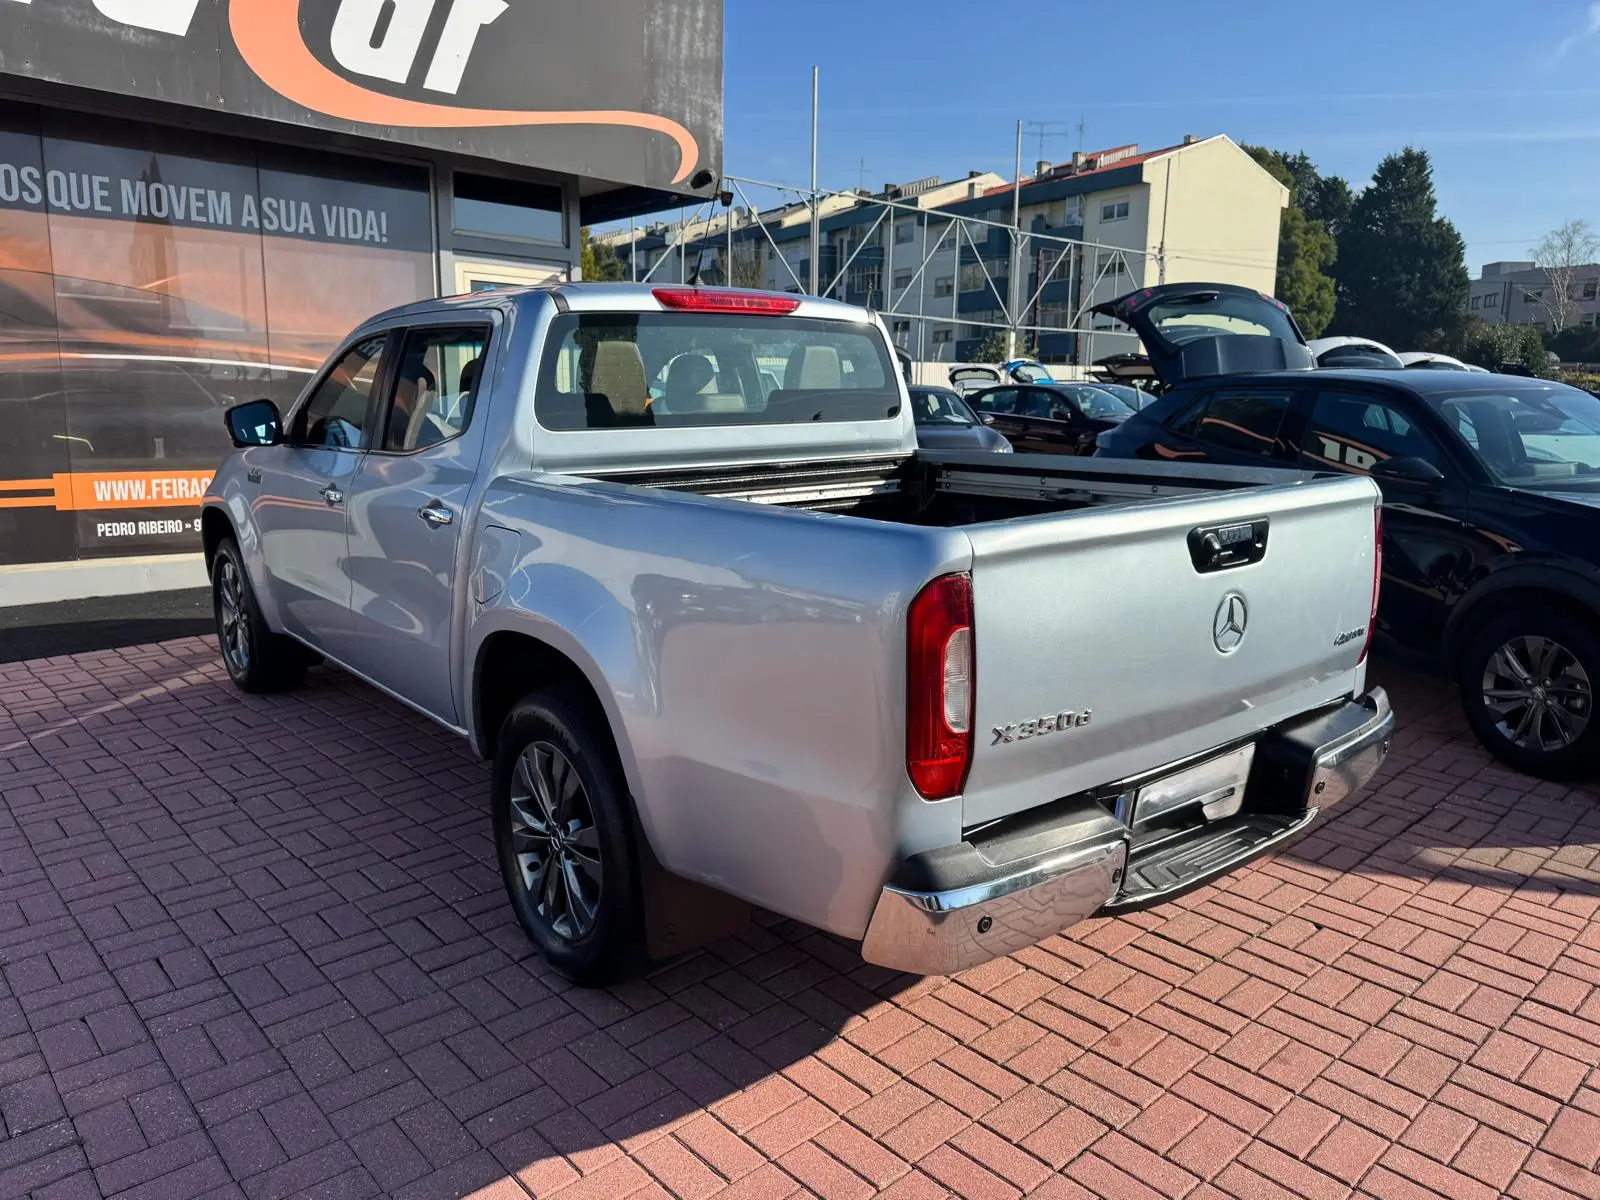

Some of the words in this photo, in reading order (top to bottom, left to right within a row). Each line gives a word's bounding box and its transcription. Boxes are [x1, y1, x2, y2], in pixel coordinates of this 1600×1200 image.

[46, 169, 112, 212] QUE
[120, 178, 232, 225] MOVEM
[321, 204, 389, 243] VIDA!
[97, 521, 136, 537] PEDRO
[138, 519, 183, 535] RIBEIRO
[990, 708, 1092, 746] X350d
